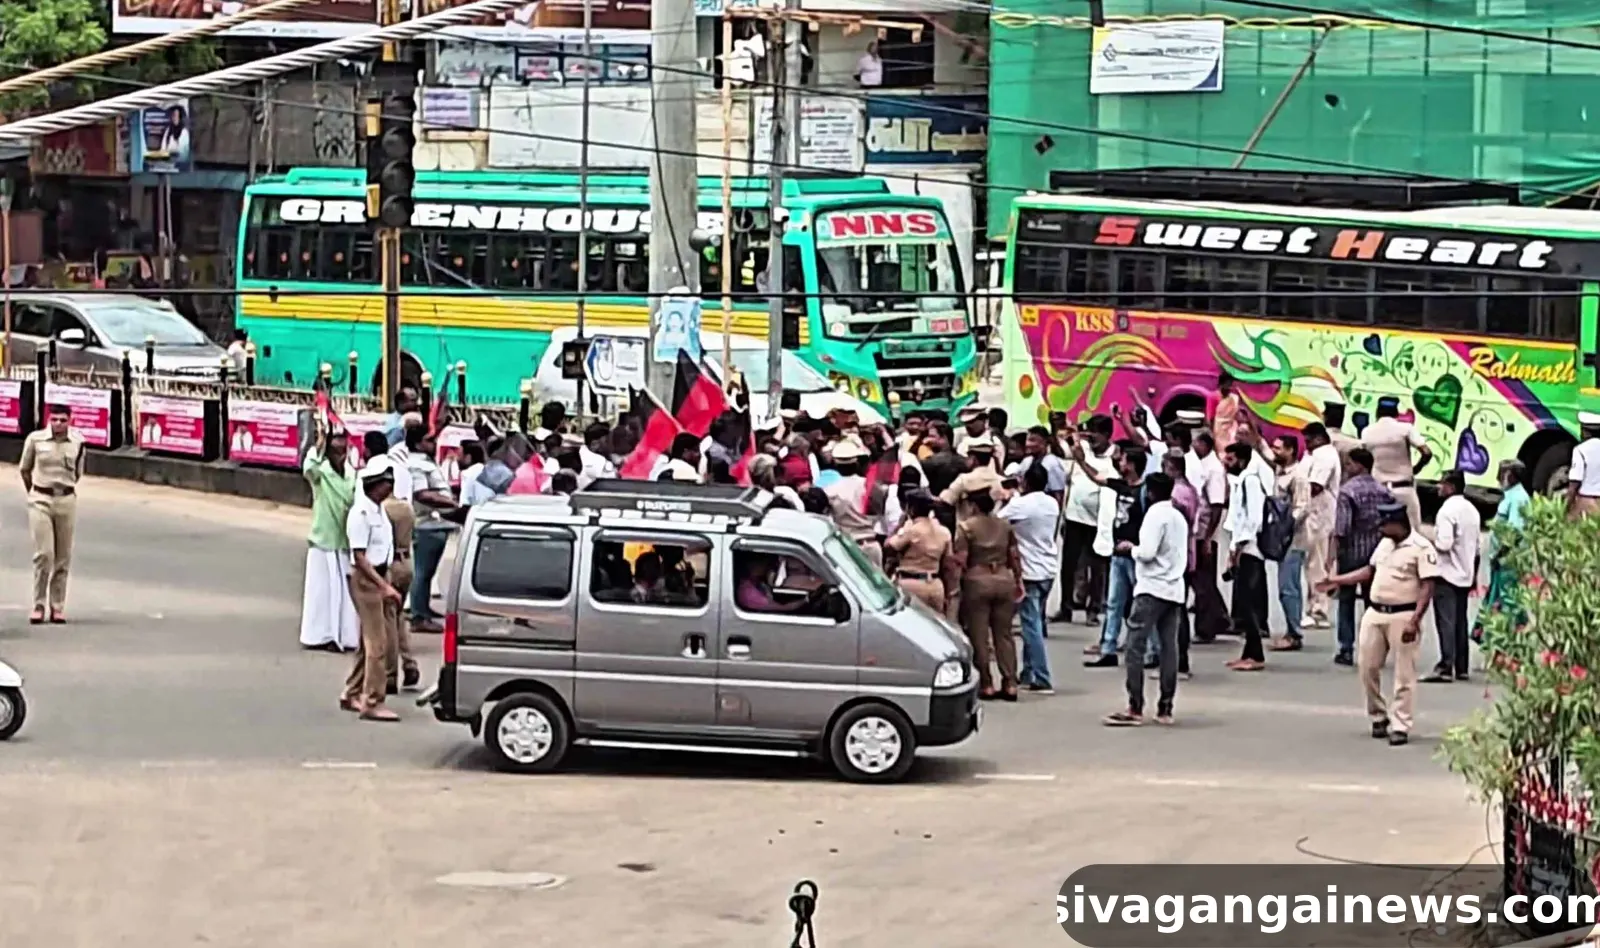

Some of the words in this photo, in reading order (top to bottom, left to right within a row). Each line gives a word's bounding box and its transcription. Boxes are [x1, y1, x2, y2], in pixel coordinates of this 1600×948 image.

[279, 198, 725, 236] GRENHOUE
[829, 212, 938, 238] NNS
[1094, 216, 1319, 255] Sweet
[1330, 228, 1554, 269] Heart
[1075, 310, 1116, 333] KSS
[1468, 346, 1577, 384] Rahmath
